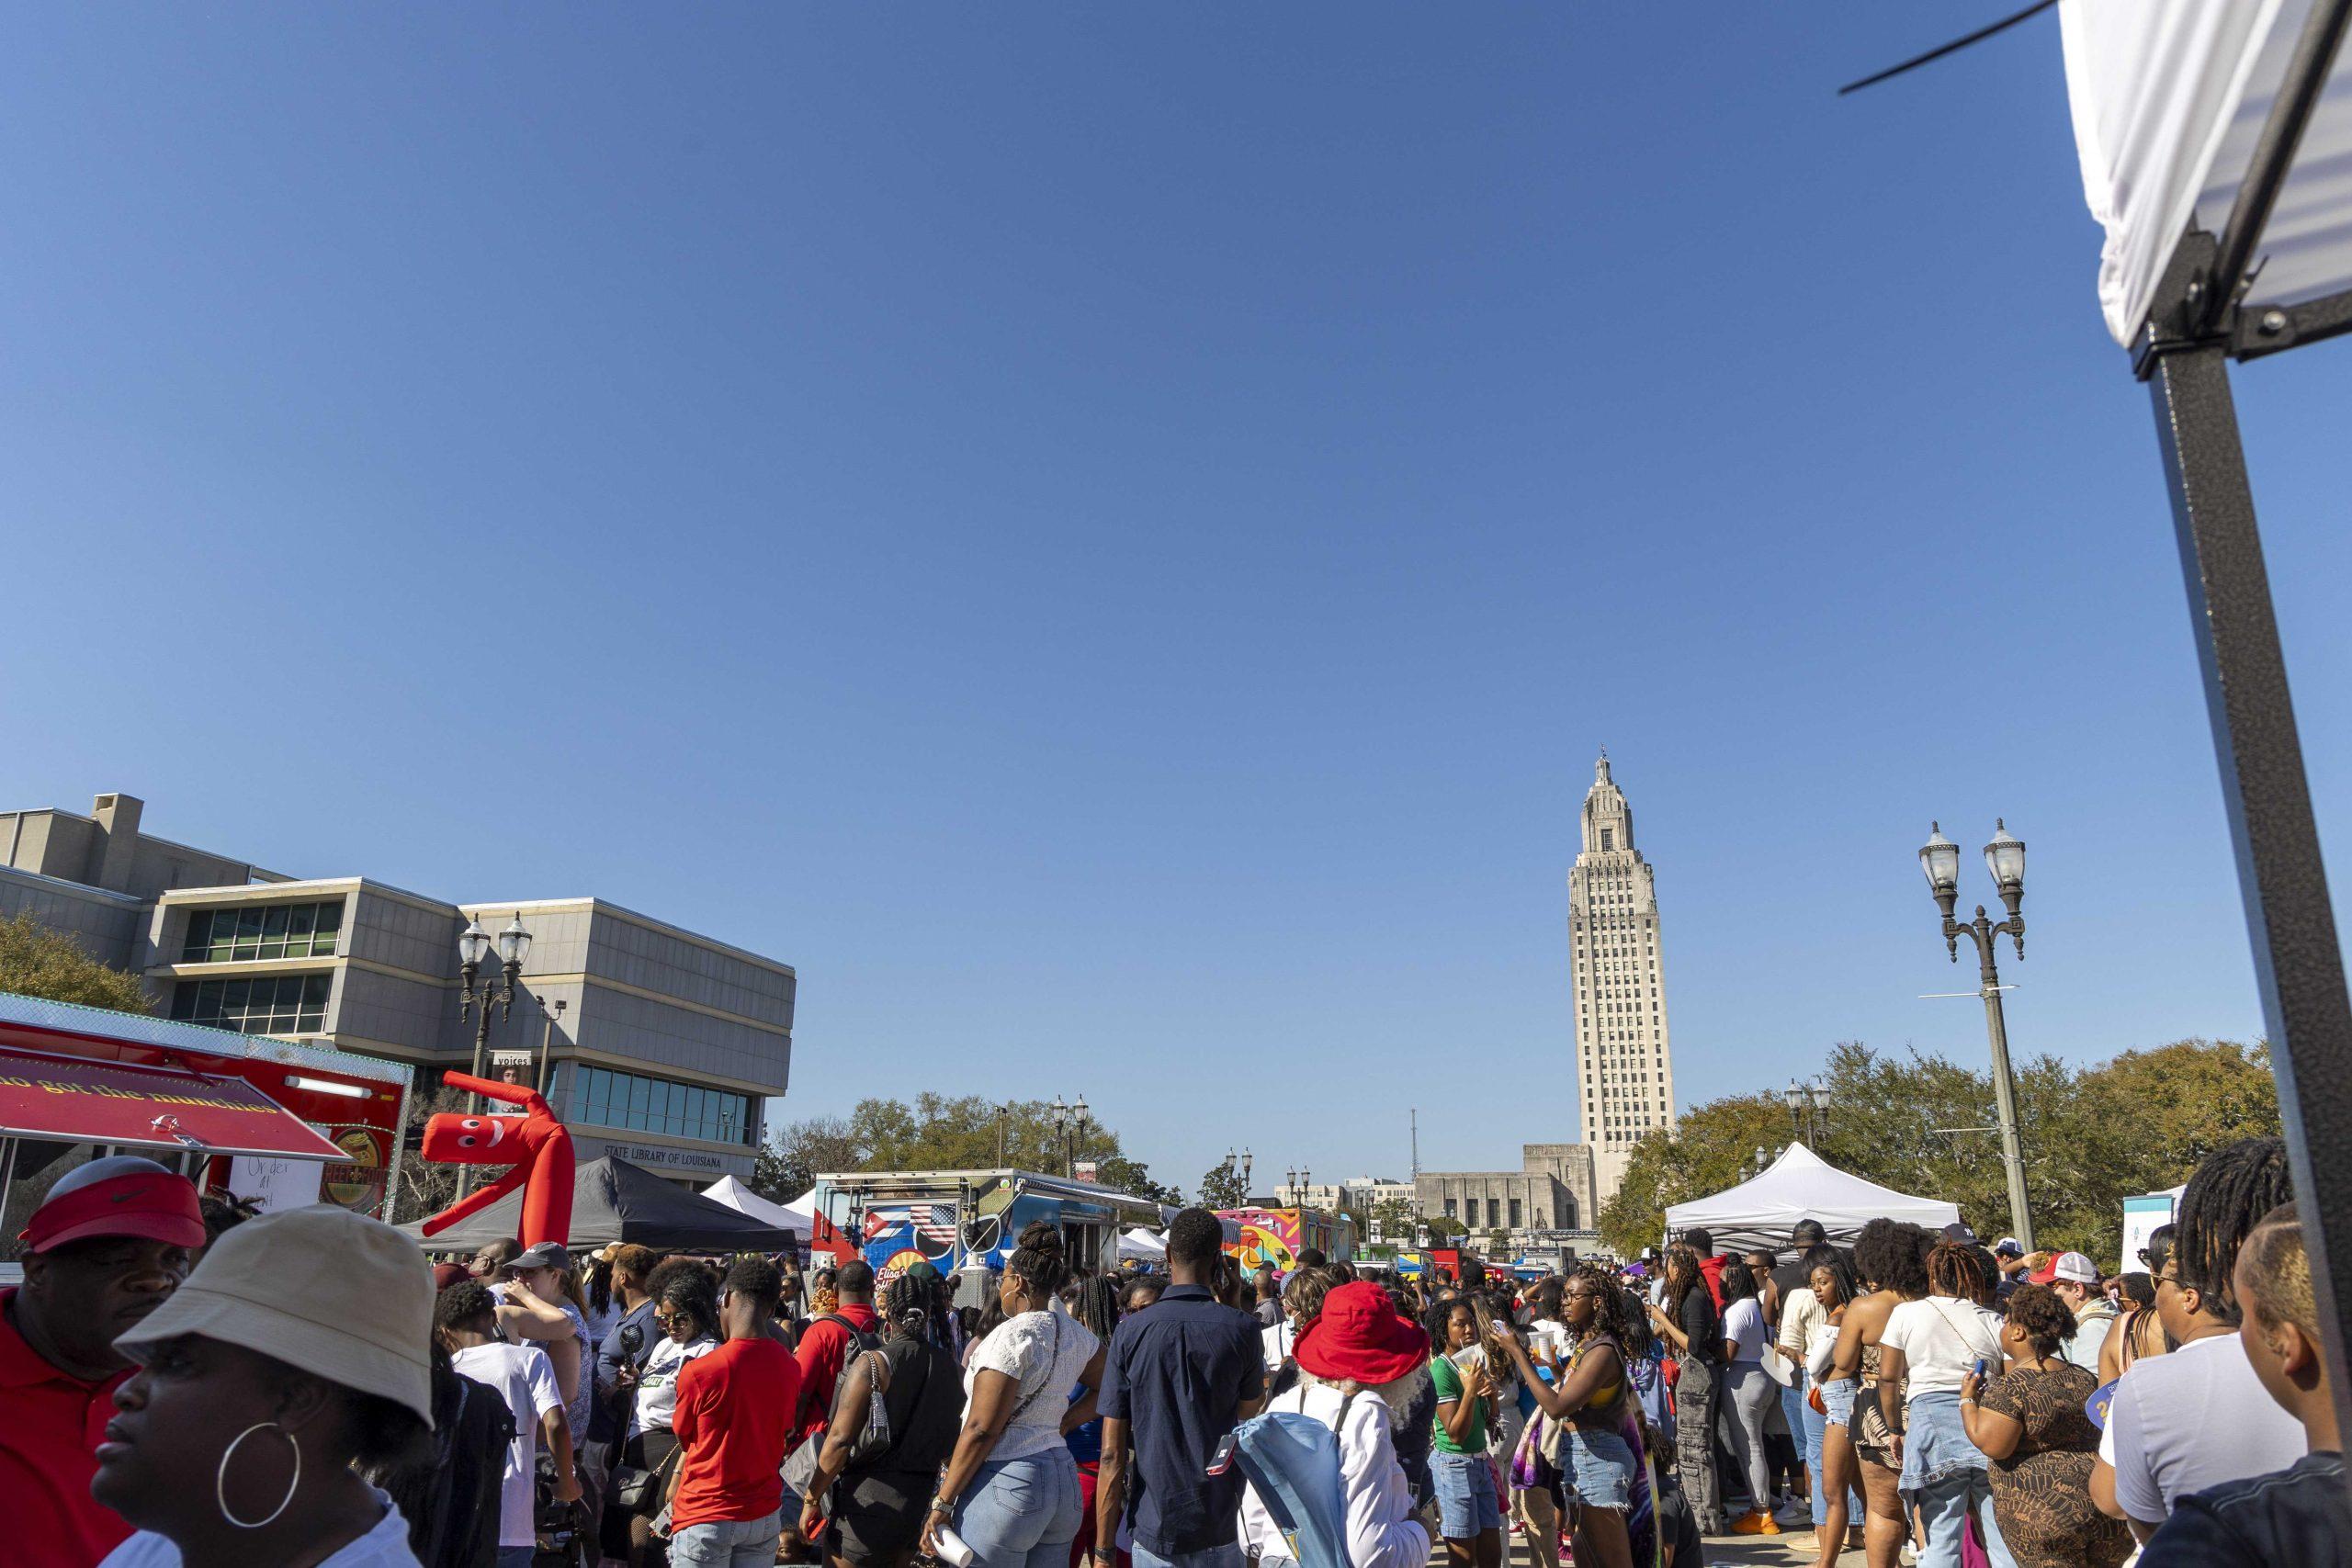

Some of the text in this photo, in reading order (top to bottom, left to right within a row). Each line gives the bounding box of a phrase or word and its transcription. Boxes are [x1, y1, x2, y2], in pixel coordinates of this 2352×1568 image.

[498, 1055, 528, 1066] voices
[37, 1079, 91, 1094] got
[90, 1083, 145, 1100] the
[147, 1090, 278, 1114] munchies
[604, 1145, 721, 1168] STATE LIBRARY OF LOUISIANA
[877, 1267, 907, 1280] Elisa's
